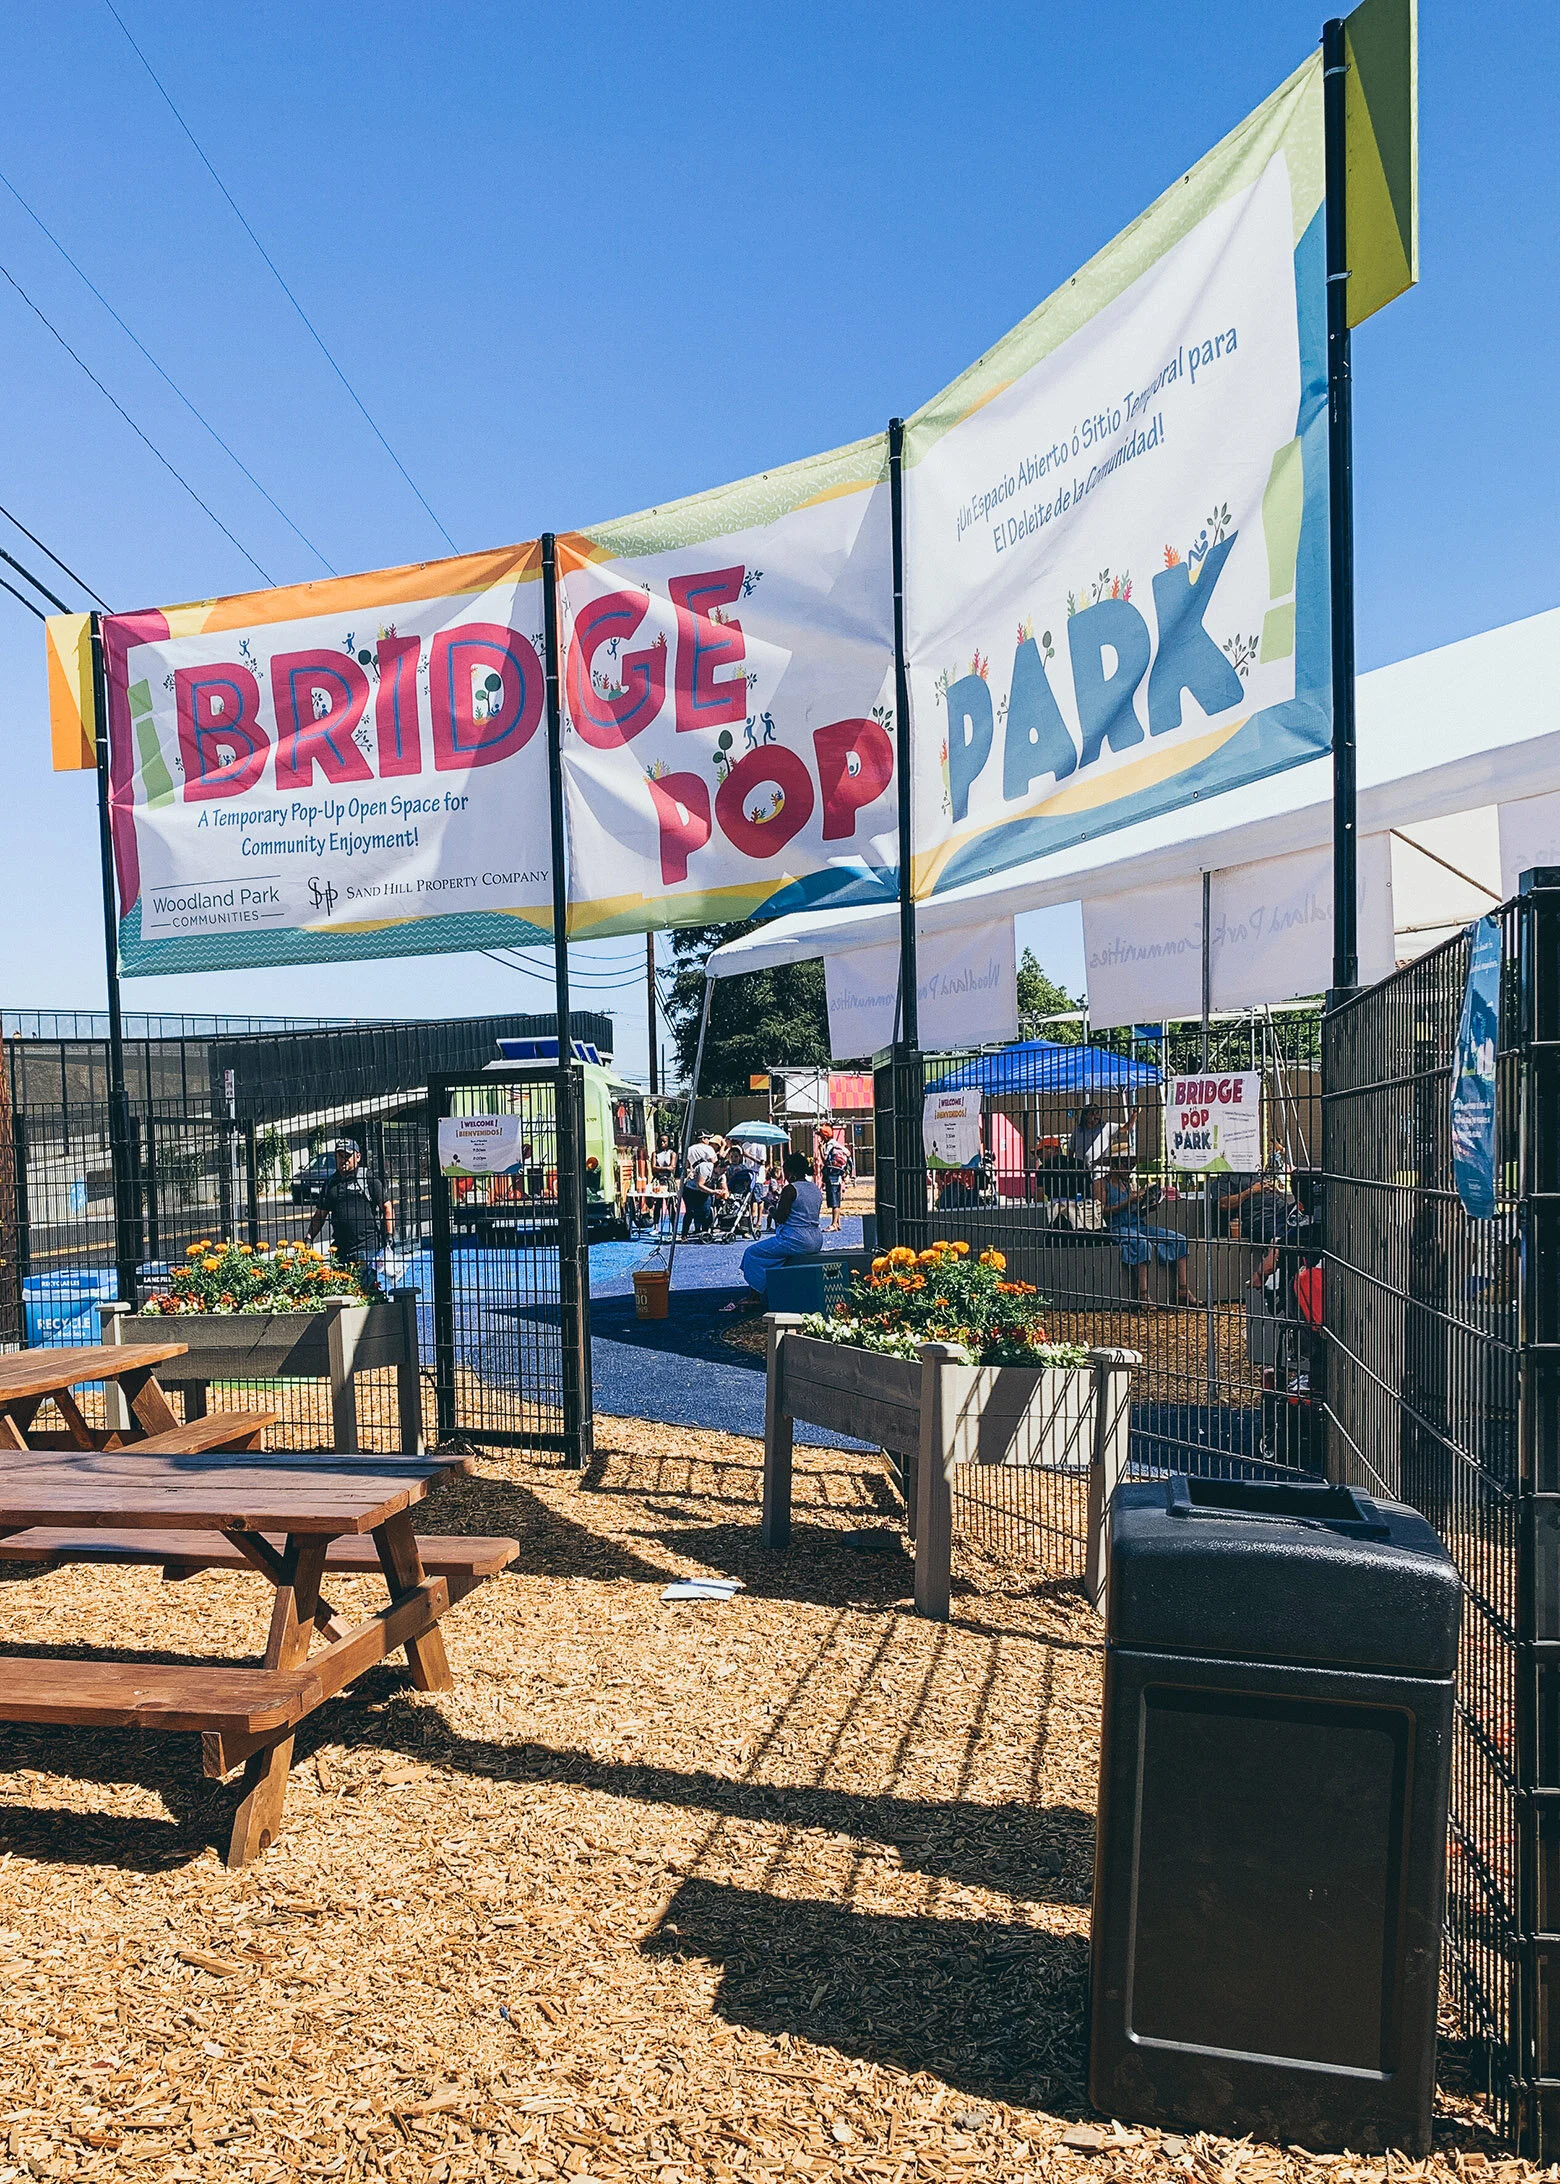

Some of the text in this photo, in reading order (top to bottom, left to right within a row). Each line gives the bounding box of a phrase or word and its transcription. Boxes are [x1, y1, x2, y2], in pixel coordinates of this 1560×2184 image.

[956, 504, 973, 542] ¡Un
[971, 474, 1015, 522] Espacio
[1018, 442, 1068, 491] Abierto
[1071, 425, 1080, 456] ó
[1082, 407, 1121, 449] Sitio
[1188, 328, 1238, 385] para
[993, 412, 1166, 553] El Deleite de la Comunidad!
[197, 791, 469, 832] A Temporary Pop-Up Open Space for
[648, 718, 894, 886] POP
[241, 826, 419, 856] Community Enjoyment!
[153, 886, 280, 913] Woodland Park
[346, 871, 549, 899] SAND HILL PROPERTY COMPANY
[172, 910, 259, 928] COMMUNITIES
[1181, 1109, 1210, 1130] POP
[37, 1317, 91, 1330] RECYCLE
